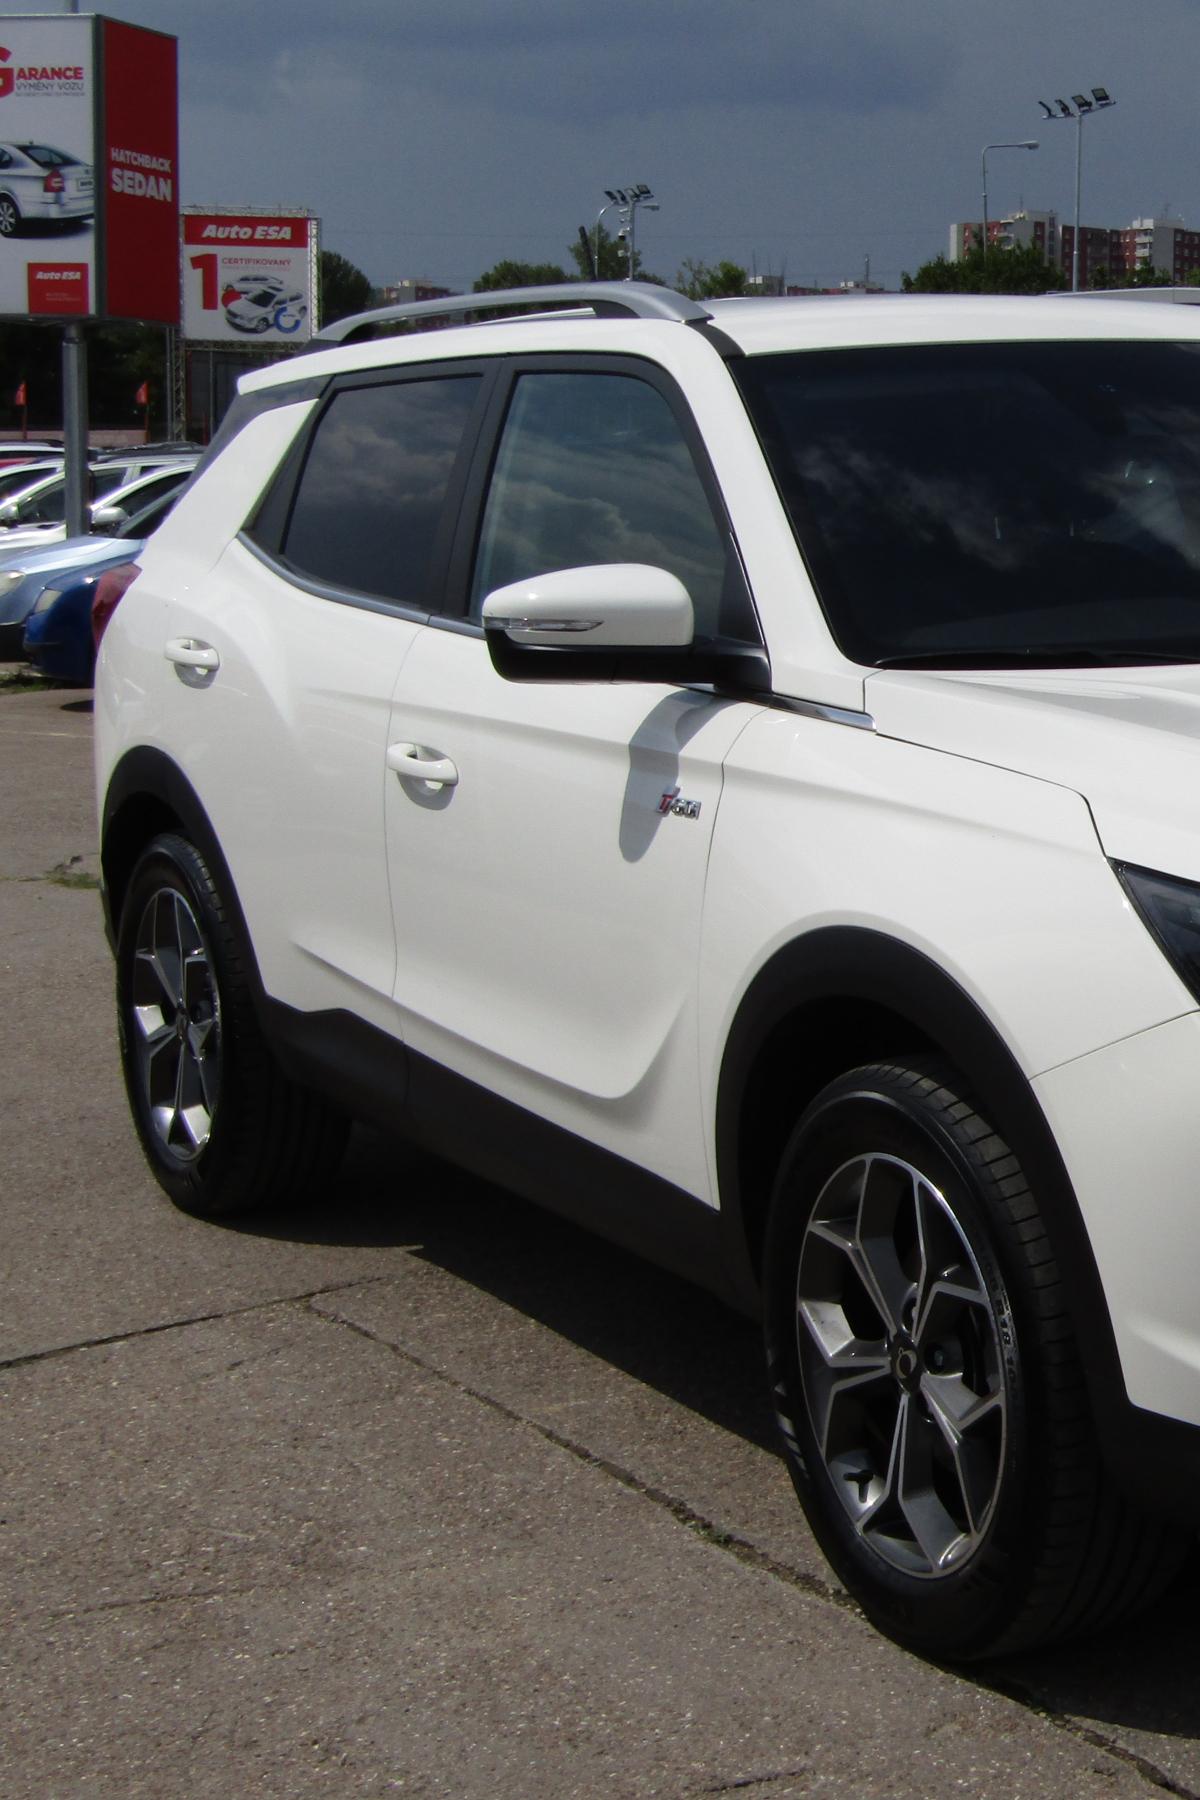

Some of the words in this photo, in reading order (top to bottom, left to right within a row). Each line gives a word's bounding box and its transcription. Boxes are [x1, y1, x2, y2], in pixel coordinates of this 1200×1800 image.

[111, 147, 171, 173] HATCHBACK
[111, 167, 172, 202] SEDAN
[202, 224, 253, 239] Auto
[254, 226, 292, 239] ESA
[36, 271, 61, 280] Auto
[62, 271, 81, 280] ESA
[190, 253, 218, 310] 1
